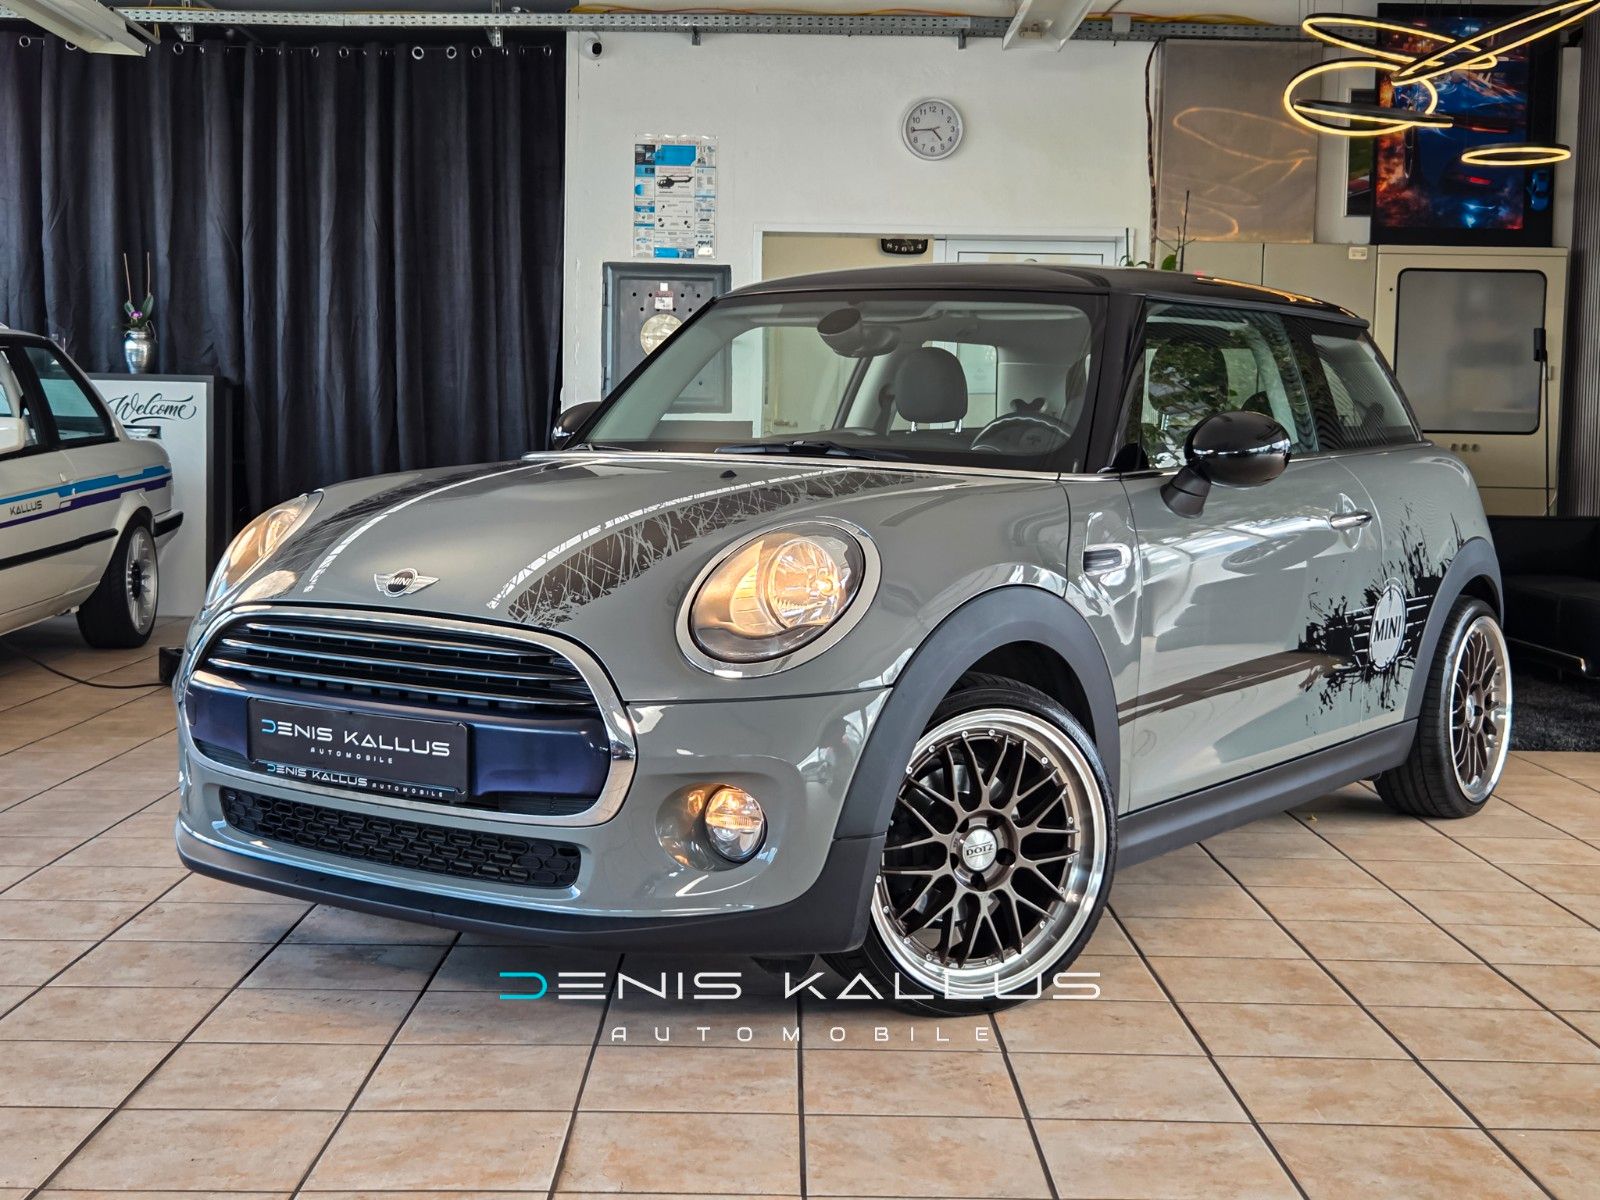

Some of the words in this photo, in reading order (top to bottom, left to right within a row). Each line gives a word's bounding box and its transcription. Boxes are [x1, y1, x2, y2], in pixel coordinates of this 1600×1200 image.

[108, 392, 197, 420] Welcome
[9, 500, 43, 516] KALLUS
[388, 577, 411, 585] MINI
[1373, 615, 1402, 643] MINI
[261, 718, 333, 742] DENIS
[344, 730, 450, 757] KALLUS
[310, 746, 393, 764] AUTOMOBILE
[266, 763, 307, 778] DENIS
[312, 769, 368, 787] KALLUS
[372, 782, 443, 798] AUTOMOBILE
[966, 843, 994, 856] DOTZ
